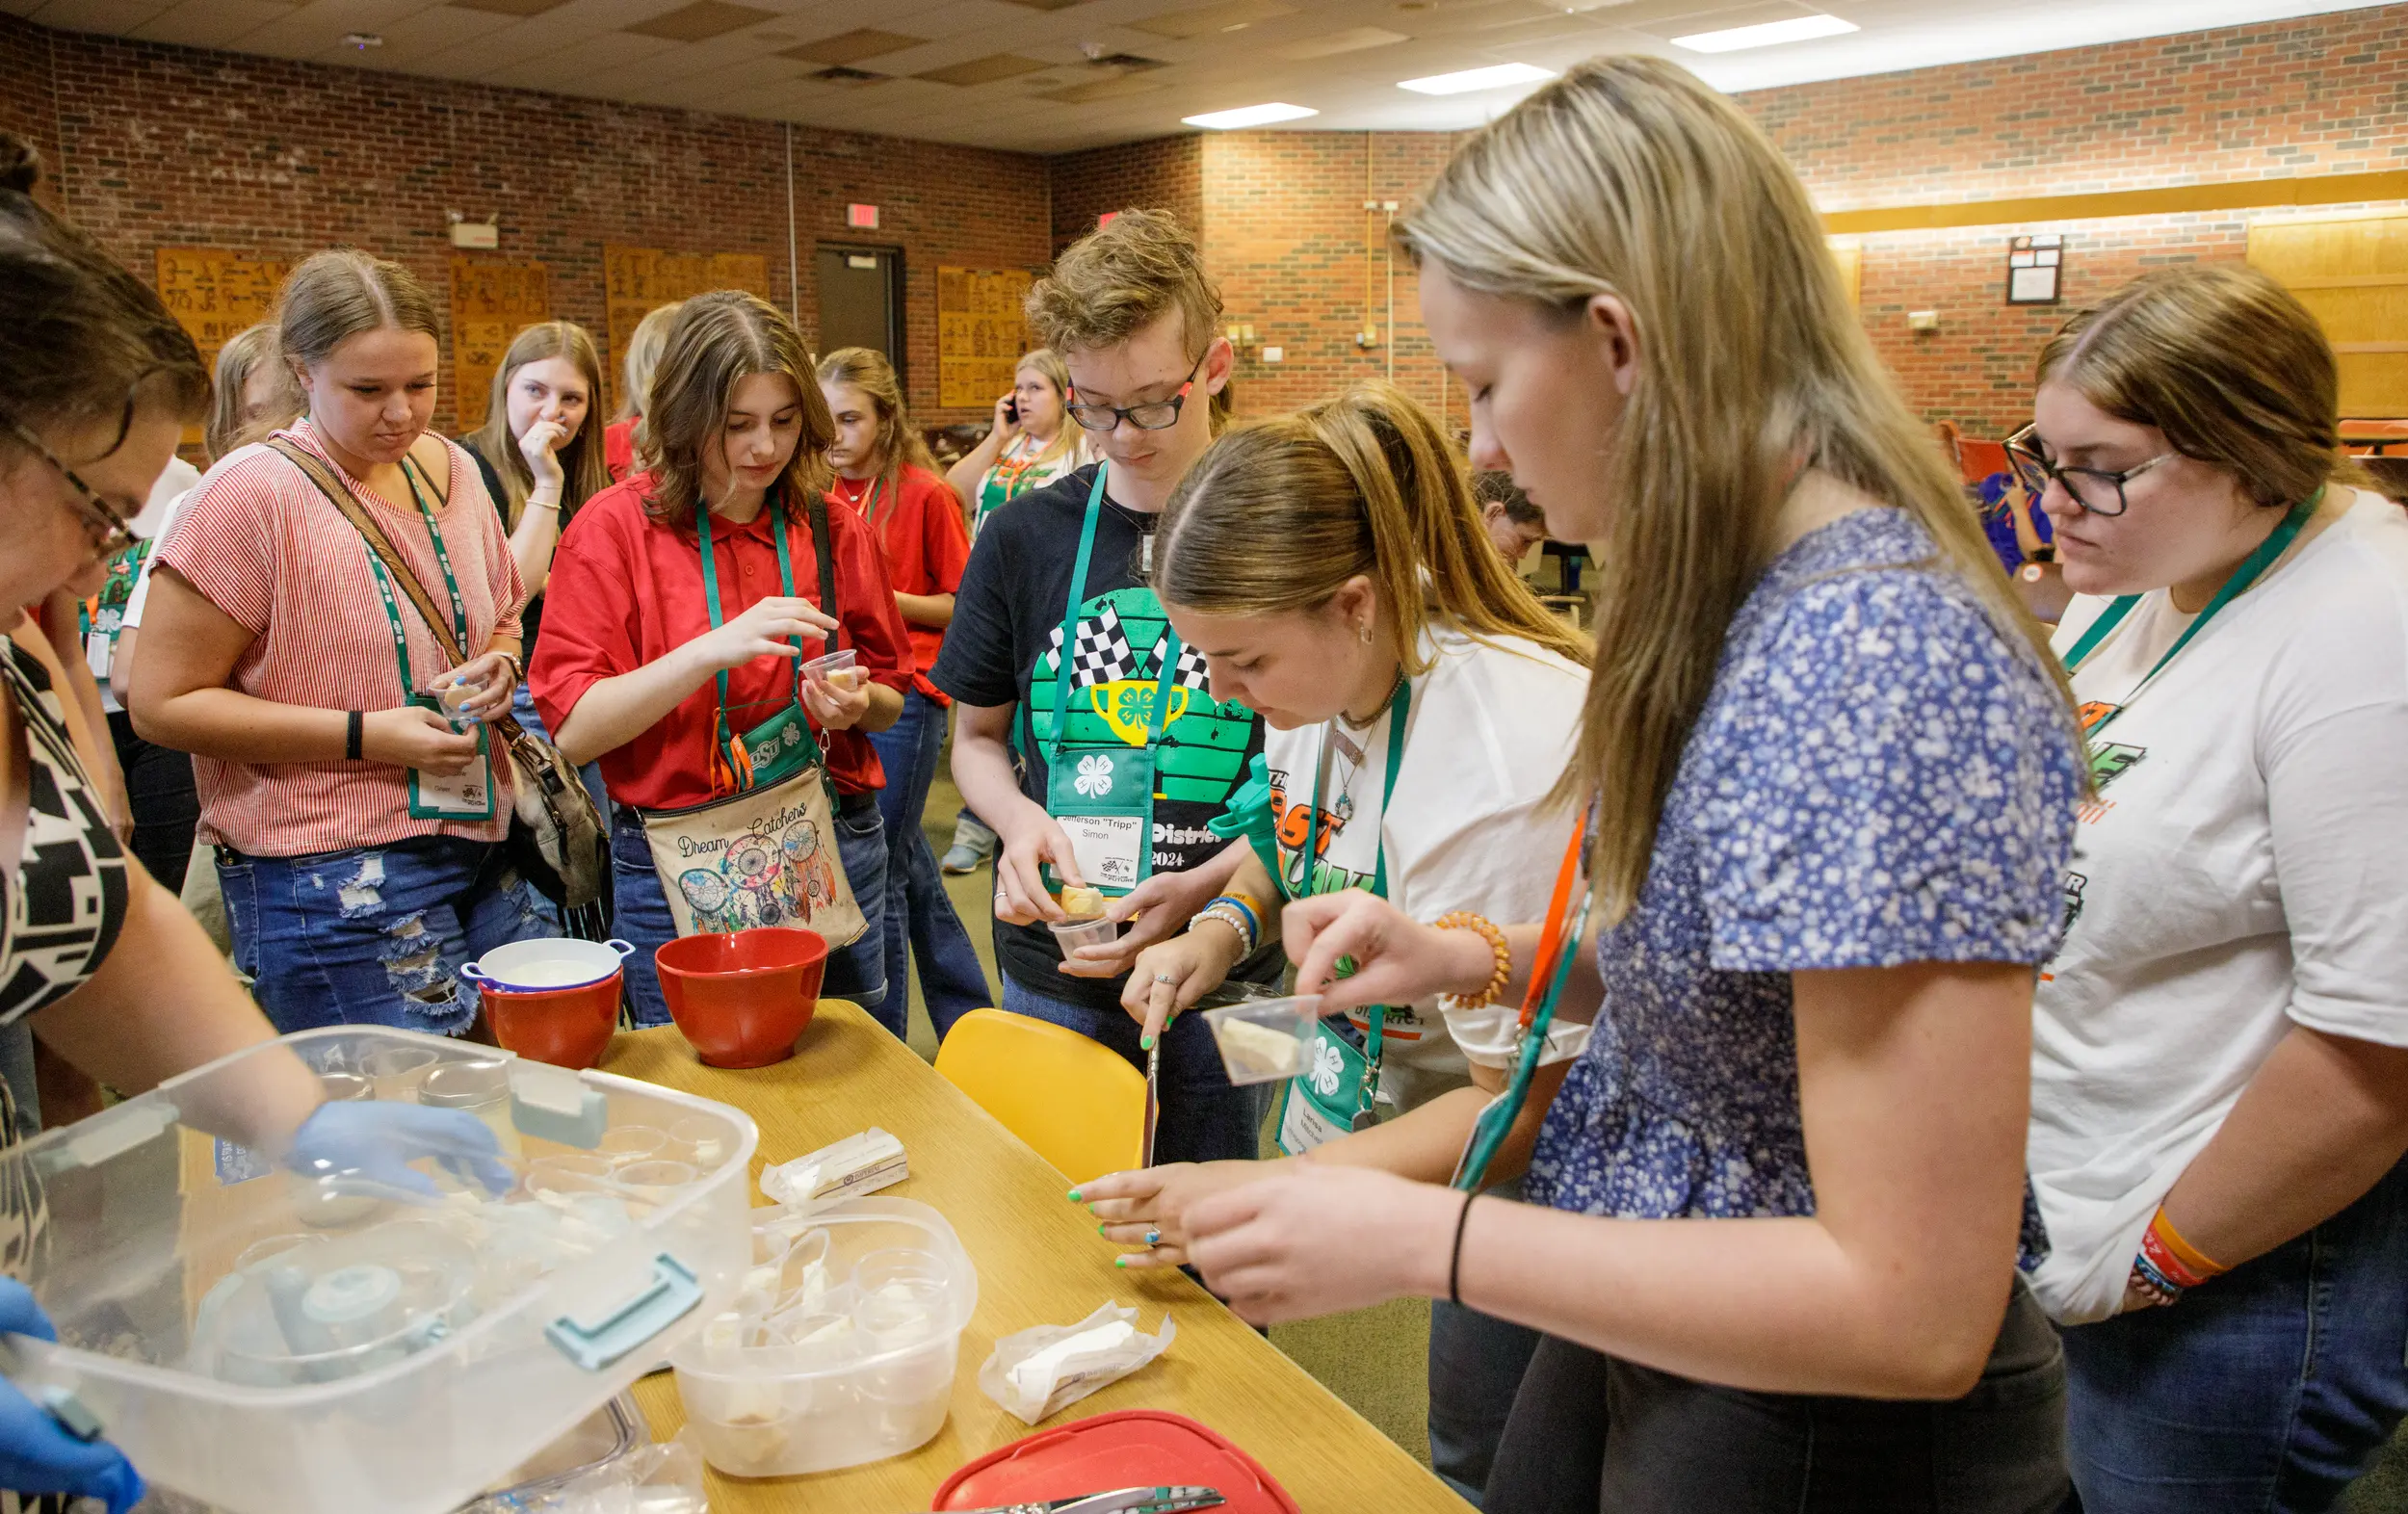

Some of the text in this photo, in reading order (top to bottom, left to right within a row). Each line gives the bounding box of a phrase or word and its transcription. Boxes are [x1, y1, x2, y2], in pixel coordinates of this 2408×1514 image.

[749, 737, 780, 770] OSU
[1269, 770, 1290, 789] TH
[677, 802, 807, 858] Dream Catchers
[1082, 828, 1110, 840] Simon
[1152, 851, 1185, 867] 2024
[1302, 1107, 1322, 1134] Larisa
